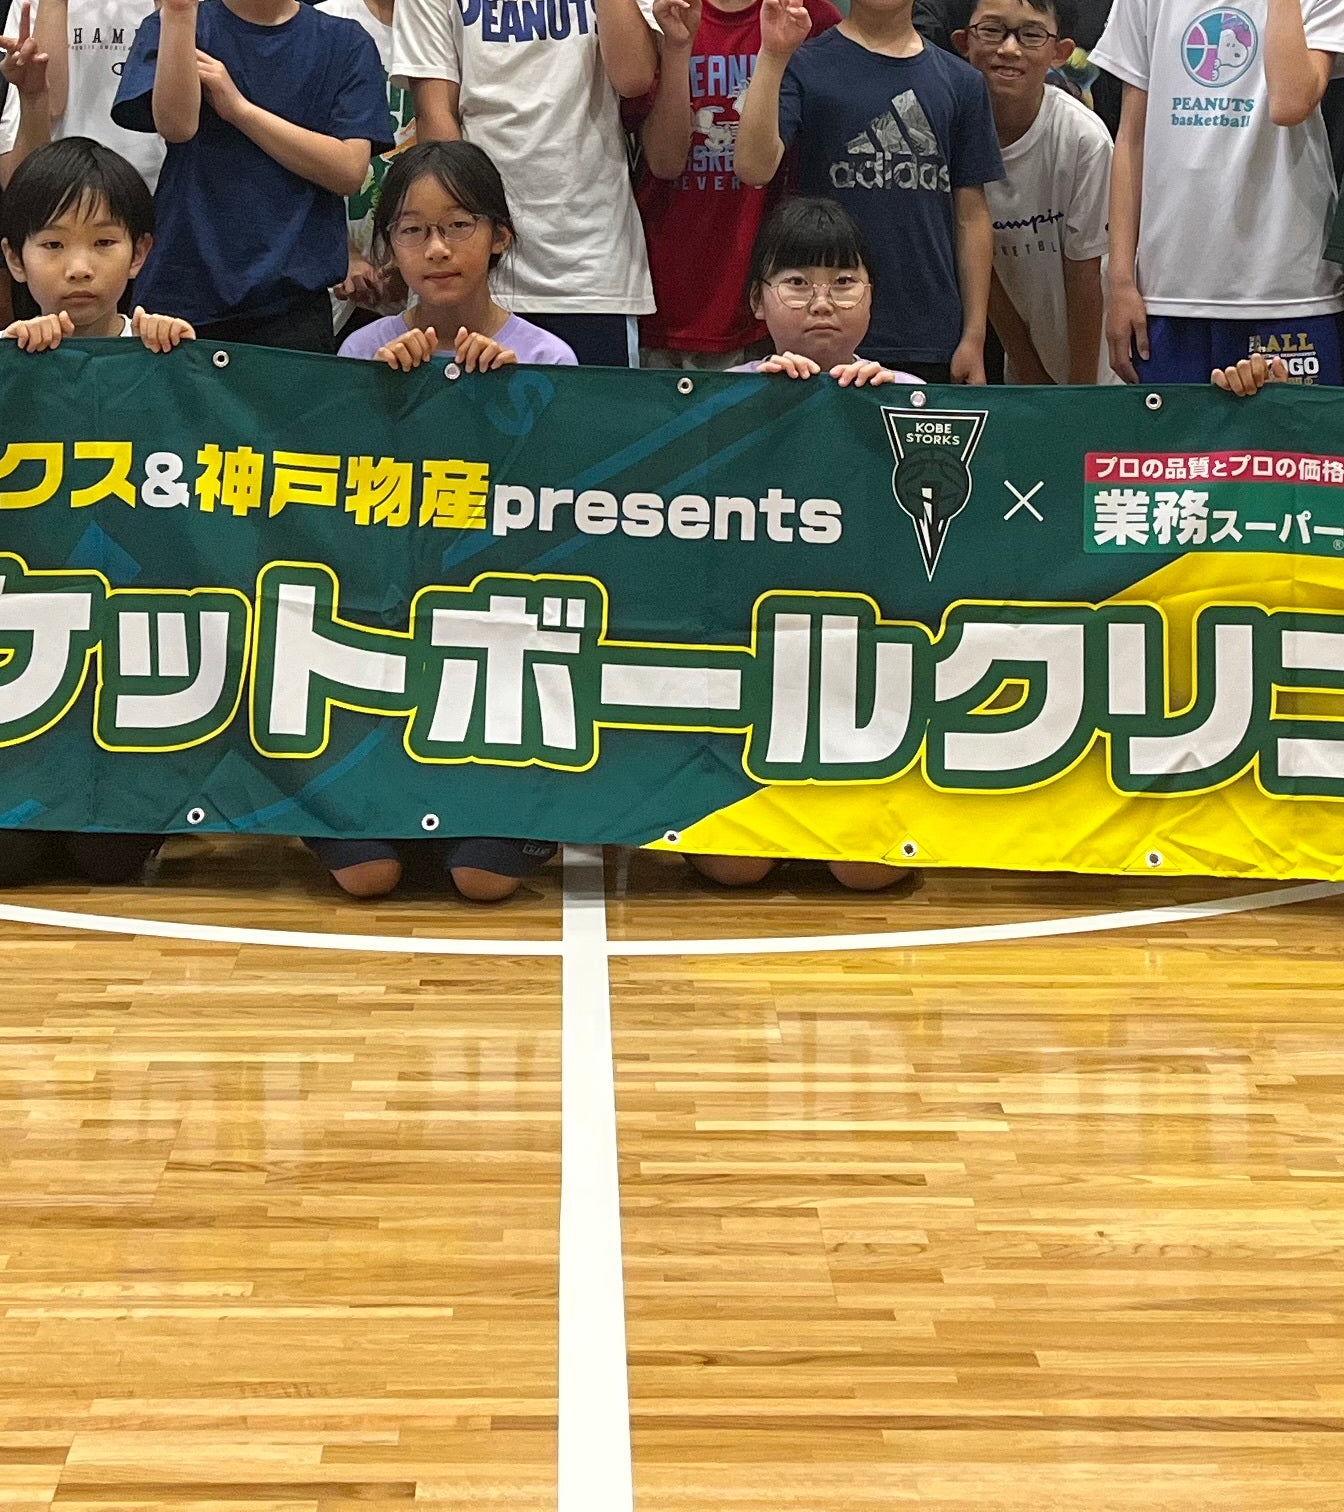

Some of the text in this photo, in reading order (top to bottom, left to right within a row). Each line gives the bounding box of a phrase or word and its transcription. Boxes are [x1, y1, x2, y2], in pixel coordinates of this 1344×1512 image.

[1171, 96, 1255, 112] PEANUTS
[1170, 113, 1251, 128] basketball
[829, 152, 951, 193] adidas
[914, 422, 952, 435] KOBE
[905, 432, 961, 446] STORKS
